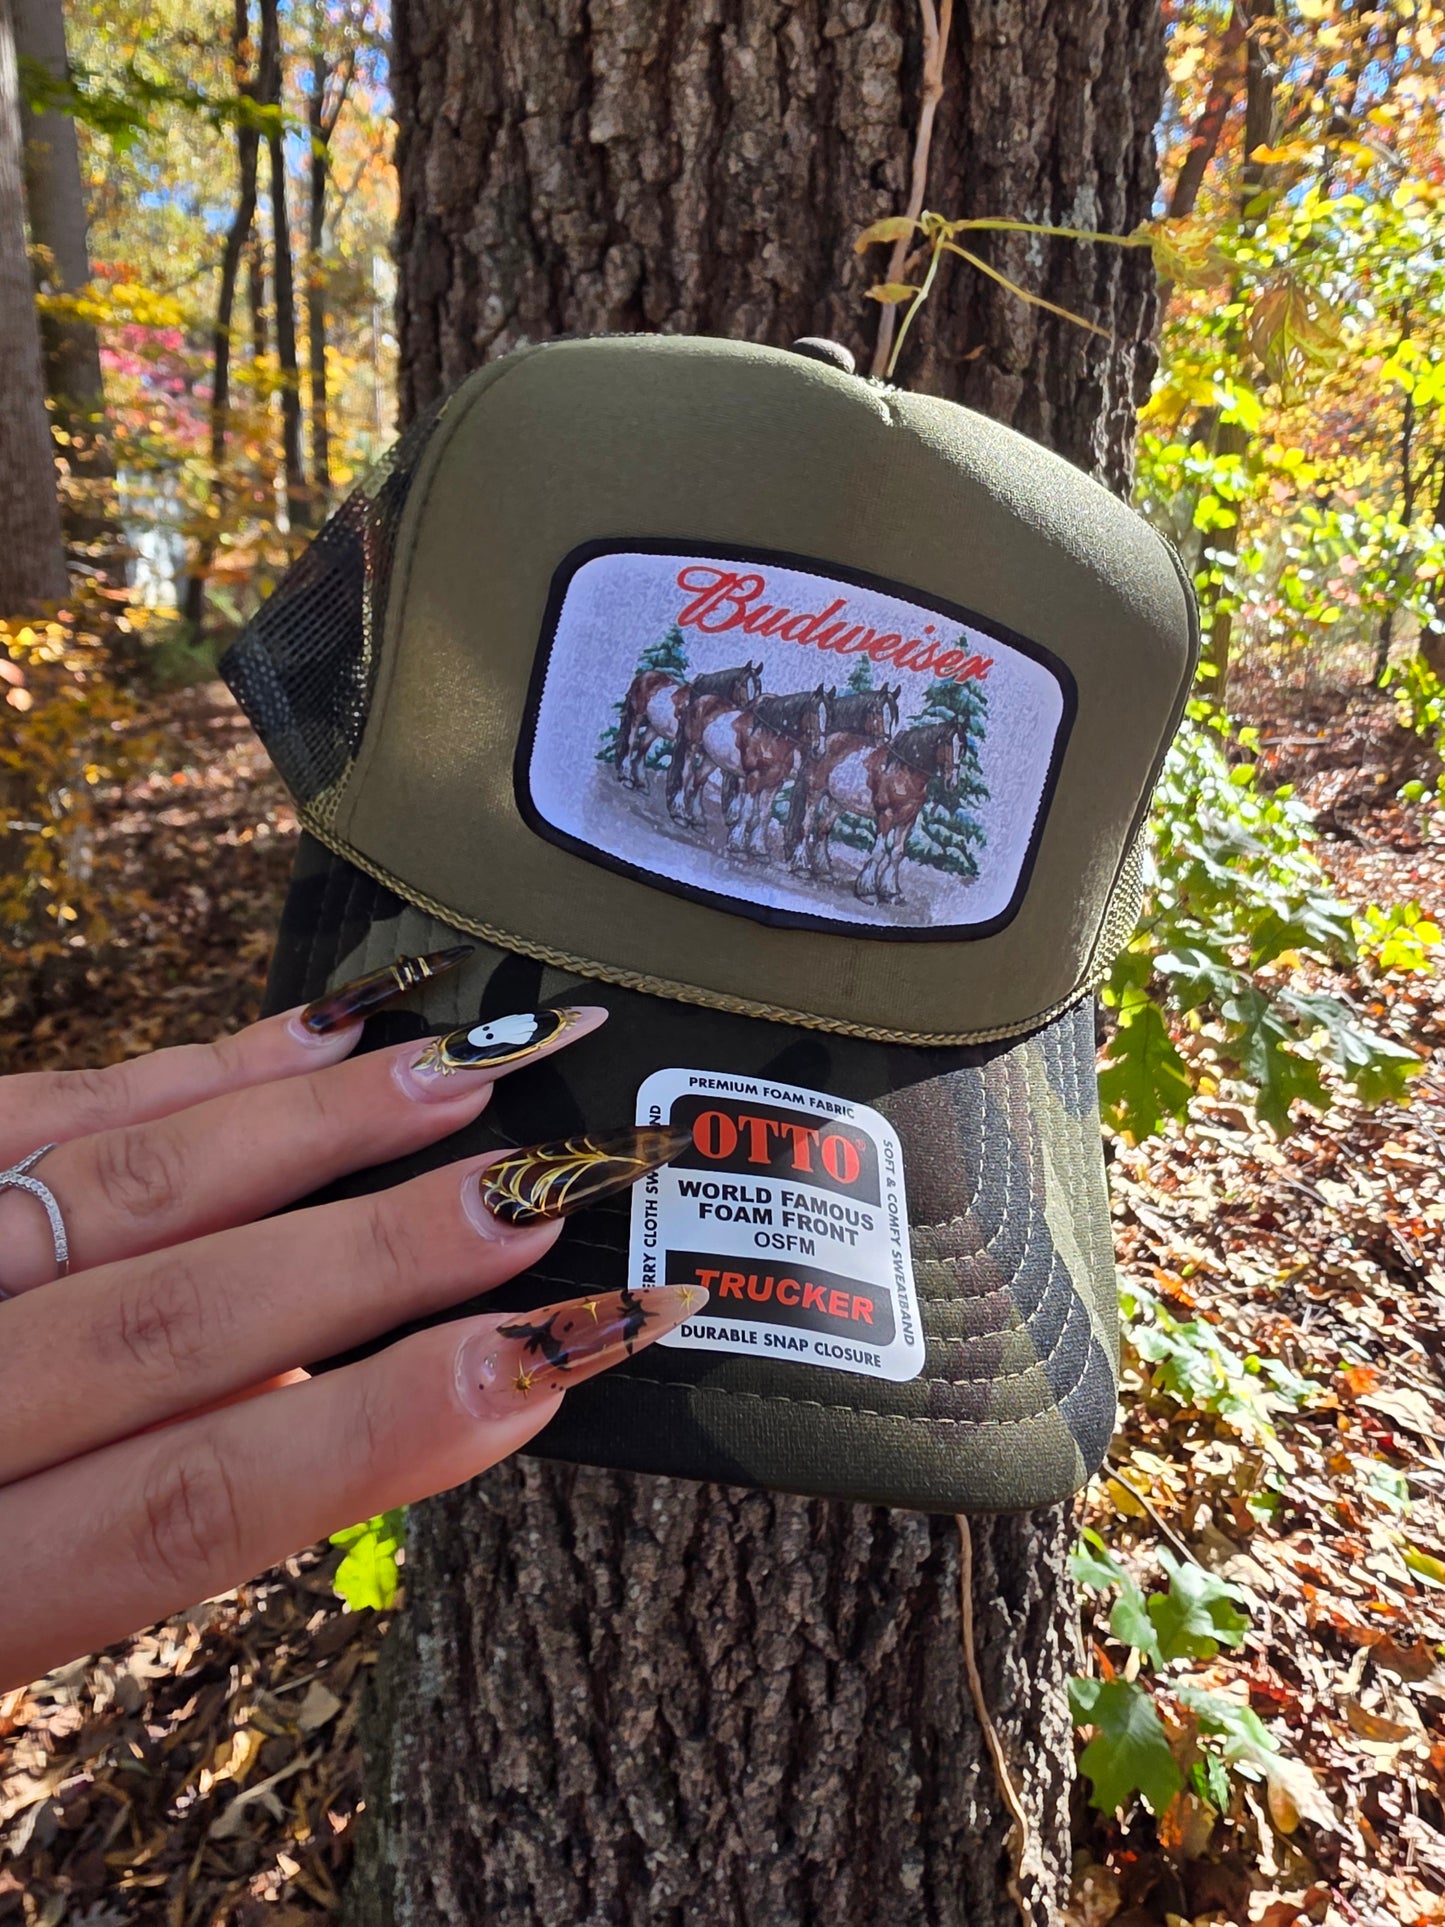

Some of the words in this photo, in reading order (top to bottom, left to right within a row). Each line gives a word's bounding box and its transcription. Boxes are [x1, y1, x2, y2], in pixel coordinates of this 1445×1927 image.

[677, 566, 994, 684] Budweiser
[689, 1076, 758, 1095] PREMIUM
[763, 1087, 805, 1105] FOAM
[809, 1097, 855, 1119] FABRIC
[883, 1139, 895, 1175] SOFT
[677, 1180, 772, 1204] WORLD
[781, 1190, 874, 1231] FAMOUS
[886, 1177, 897, 1188] &
[644, 1199, 659, 1248] CLOTH
[699, 1202, 773, 1225] FOAM
[782, 1212, 859, 1246] FRONT
[887, 1193, 902, 1247] COMFY
[754, 1231, 815, 1256] OSFM
[695, 1268, 874, 1325] TRUCKER
[891, 1249, 915, 1346] SWEATBAND
[680, 1324, 758, 1345] DURABLE
[763, 1333, 809, 1352] SNAP
[814, 1342, 882, 1368] CLOSURE
